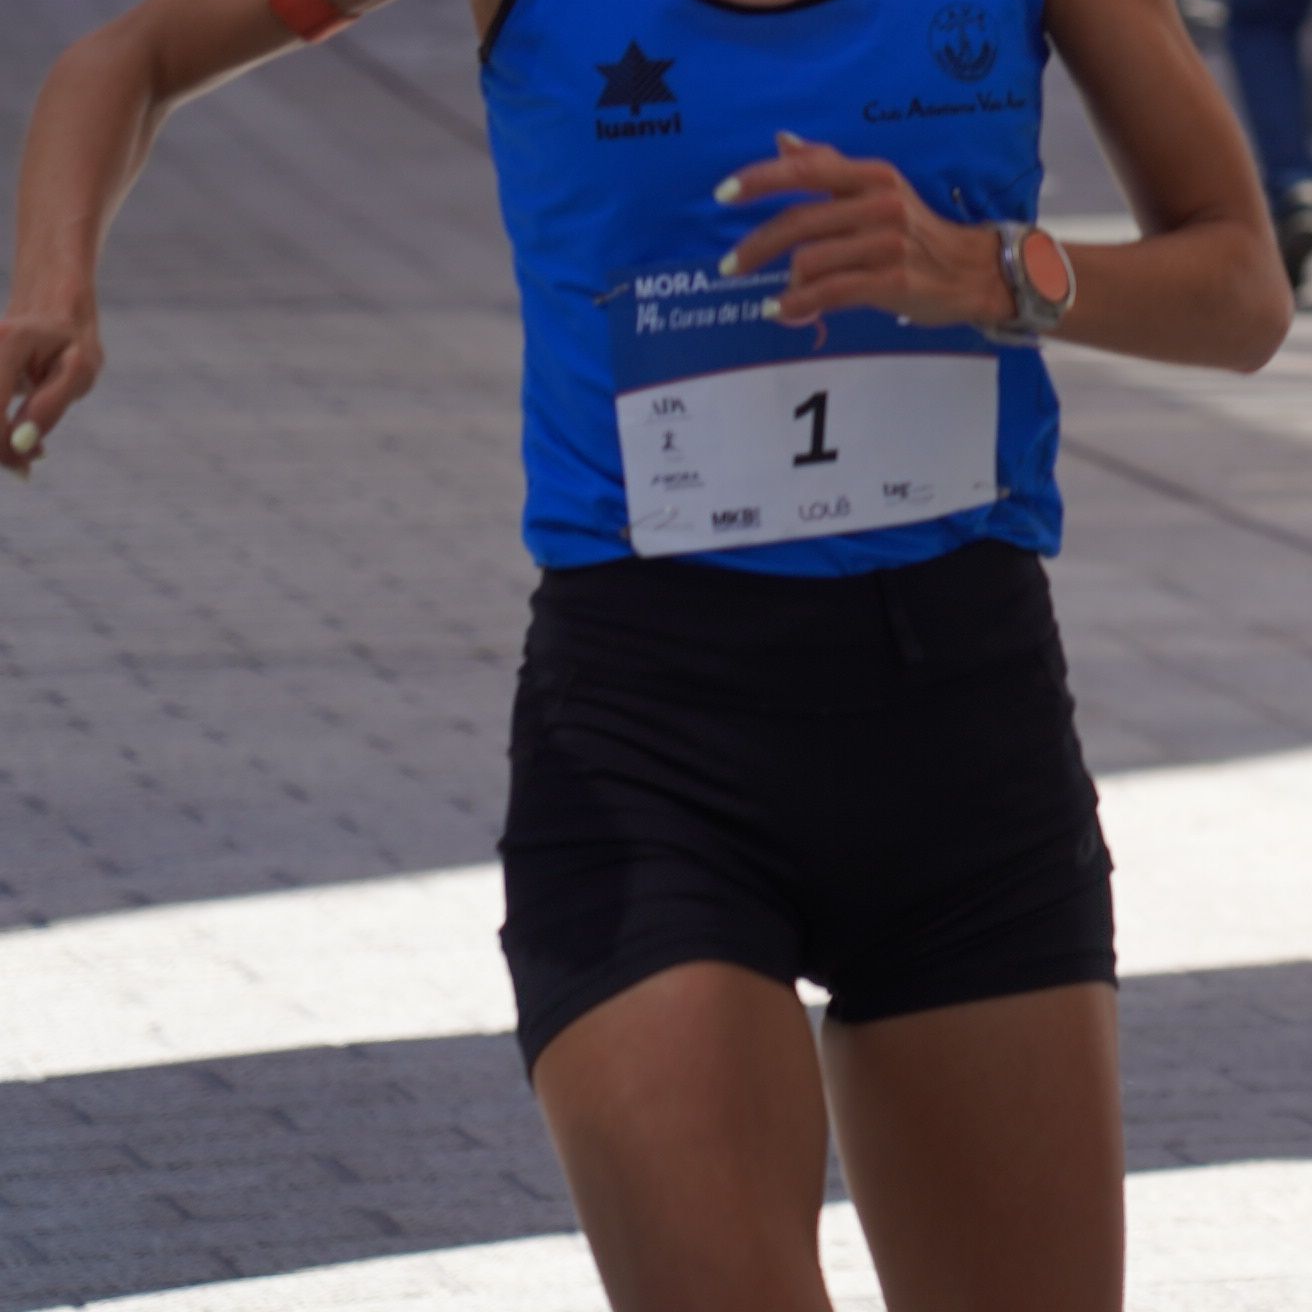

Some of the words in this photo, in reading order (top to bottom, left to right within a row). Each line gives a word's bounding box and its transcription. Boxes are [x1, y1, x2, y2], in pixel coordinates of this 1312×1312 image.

[595, 112, 682, 142] luanvi
[635, 270, 709, 299] MORA
[717, 302, 738, 325] de
[792, 390, 839, 468] 1
